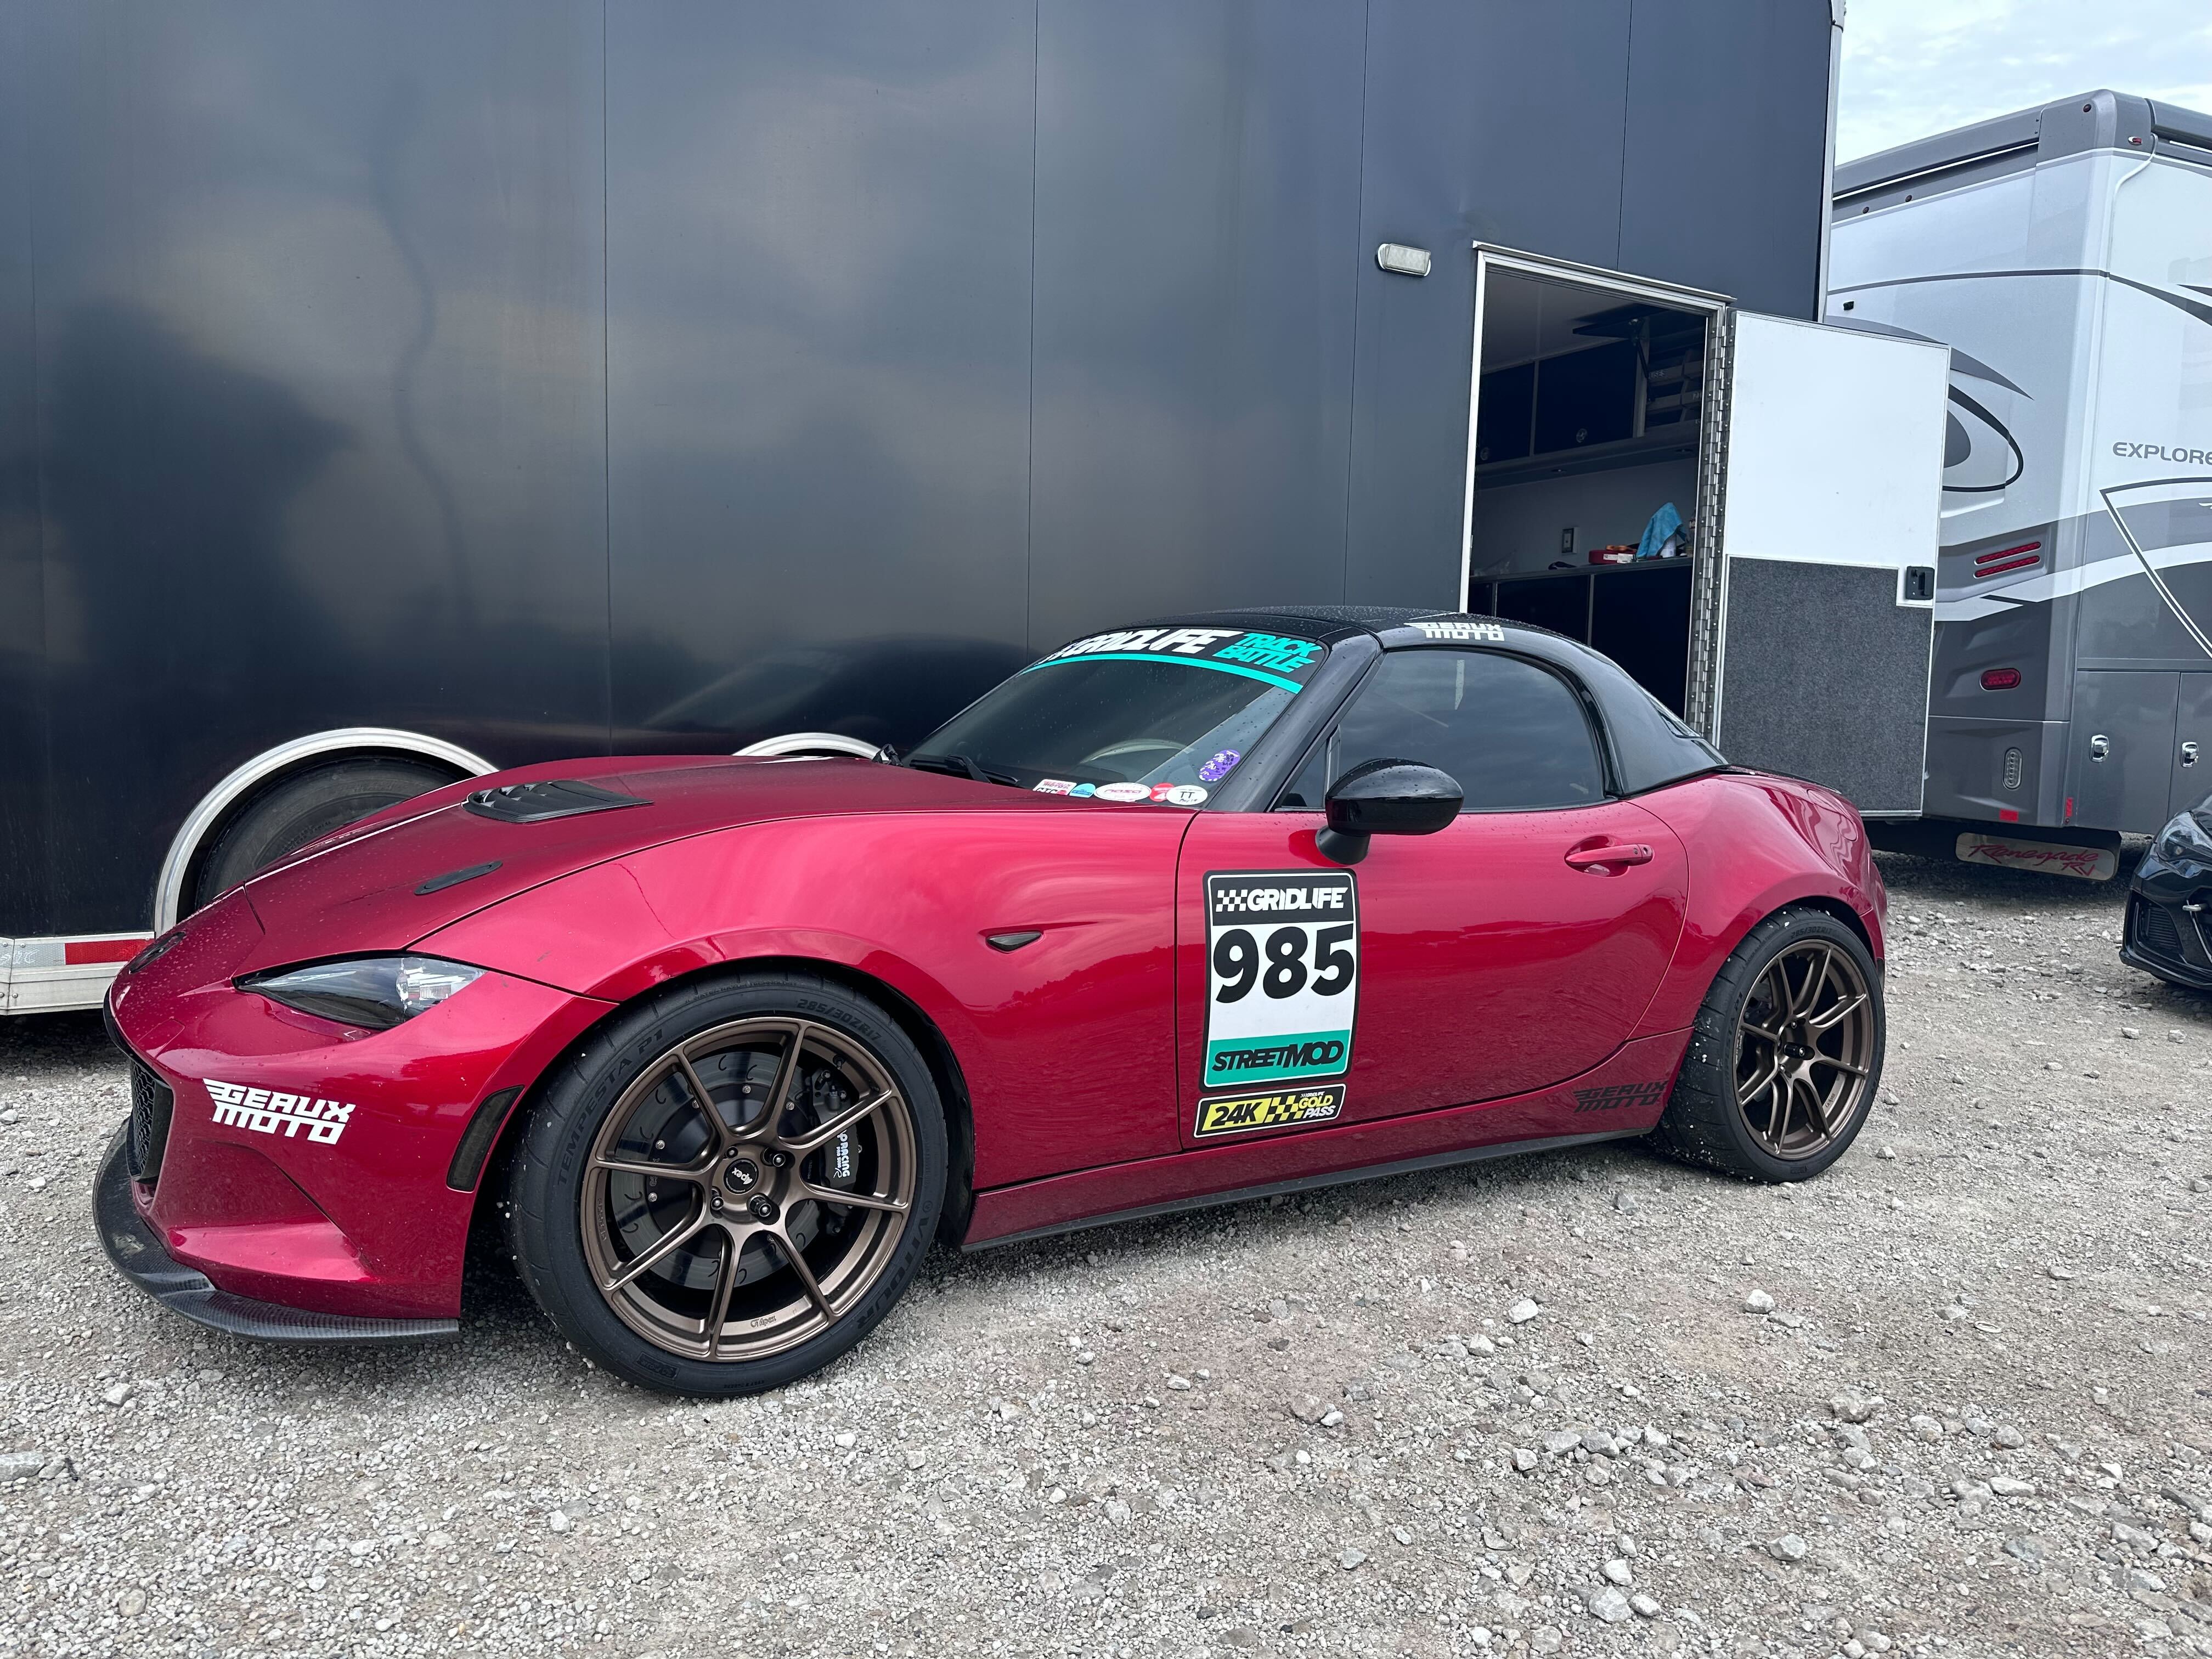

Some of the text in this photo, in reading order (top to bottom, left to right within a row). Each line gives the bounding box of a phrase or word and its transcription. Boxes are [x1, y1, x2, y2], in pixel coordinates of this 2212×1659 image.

[1236, 633, 1323, 657] TRACK
[1423, 629, 1504, 641] MOTO
[1212, 645, 1317, 673] BATTLE
[1968, 844, 2098, 866] Renegade
[2062, 862, 2100, 876] RV
[1247, 887, 1348, 911] GRIDLIFE
[1213, 923, 1355, 1003] 985
[797, 998, 883, 1042] 285/30ZR17
[202, 1078, 356, 1123] GEAUX
[557, 1029, 663, 1186] TEMPESTA P1
[1299, 1095, 1334, 1109] GOLD
[1302, 1105, 1336, 1119] PASS
[212, 1101, 346, 1145] MOTO
[1210, 1102, 1263, 1127] 24K
